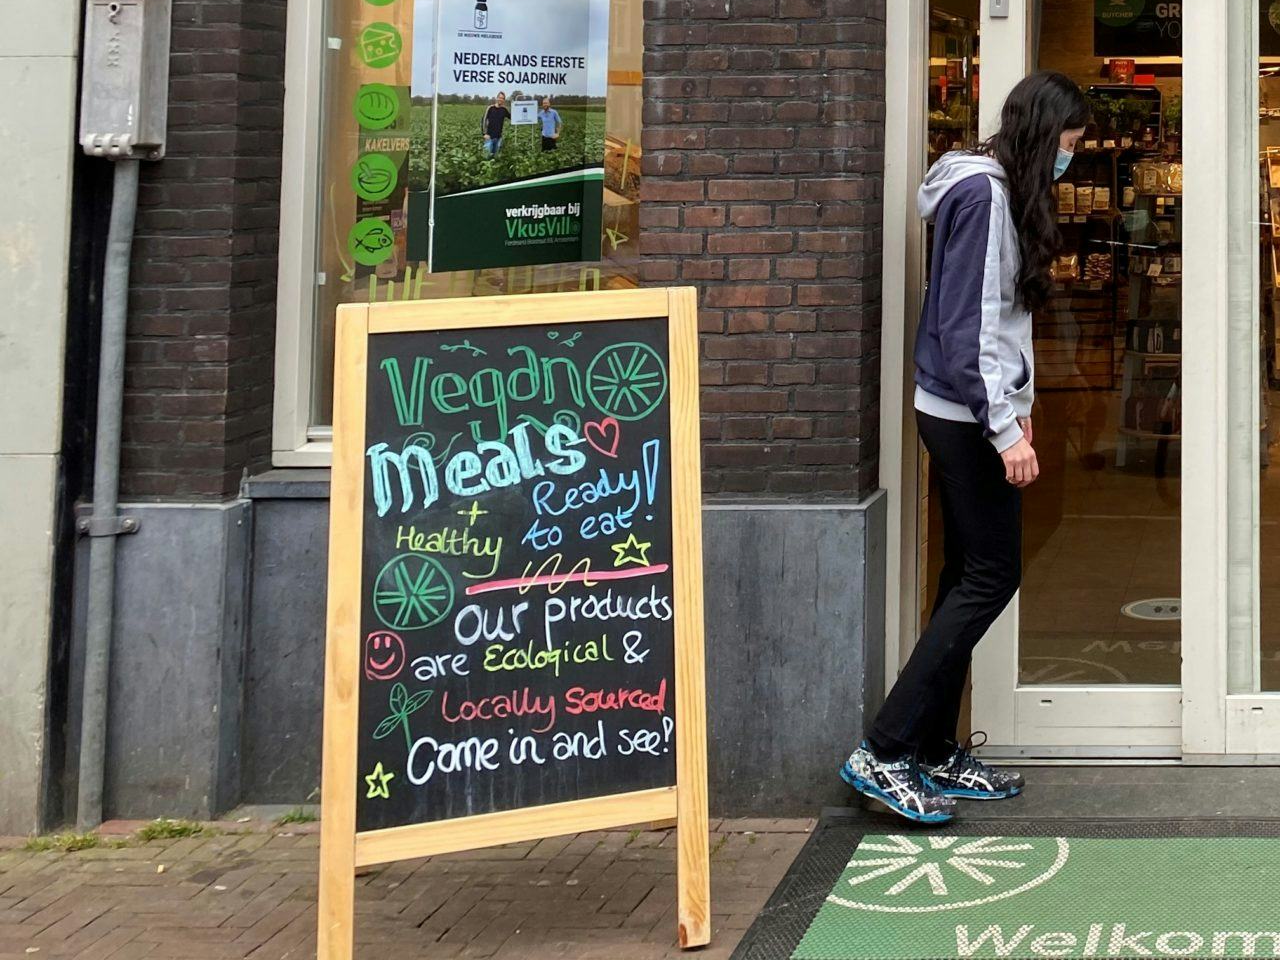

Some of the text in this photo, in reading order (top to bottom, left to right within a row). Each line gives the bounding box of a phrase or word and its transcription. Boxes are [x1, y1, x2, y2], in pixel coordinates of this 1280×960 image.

[453, 52, 585, 69] NEDERLANDS EERSTE
[453, 70, 567, 85] VERSE SOJADRINK
[505, 216, 570, 239] VkusVill
[506, 202, 581, 219] verkrijgbaar bij
[380, 345, 586, 443] Vegan
[396, 525, 503, 579] Healthy
[521, 507, 633, 551] to eat
[454, 585, 673, 650] Our products
[410, 630, 650, 682] are Ecological &
[405, 715, 674, 786] Come in and see!
